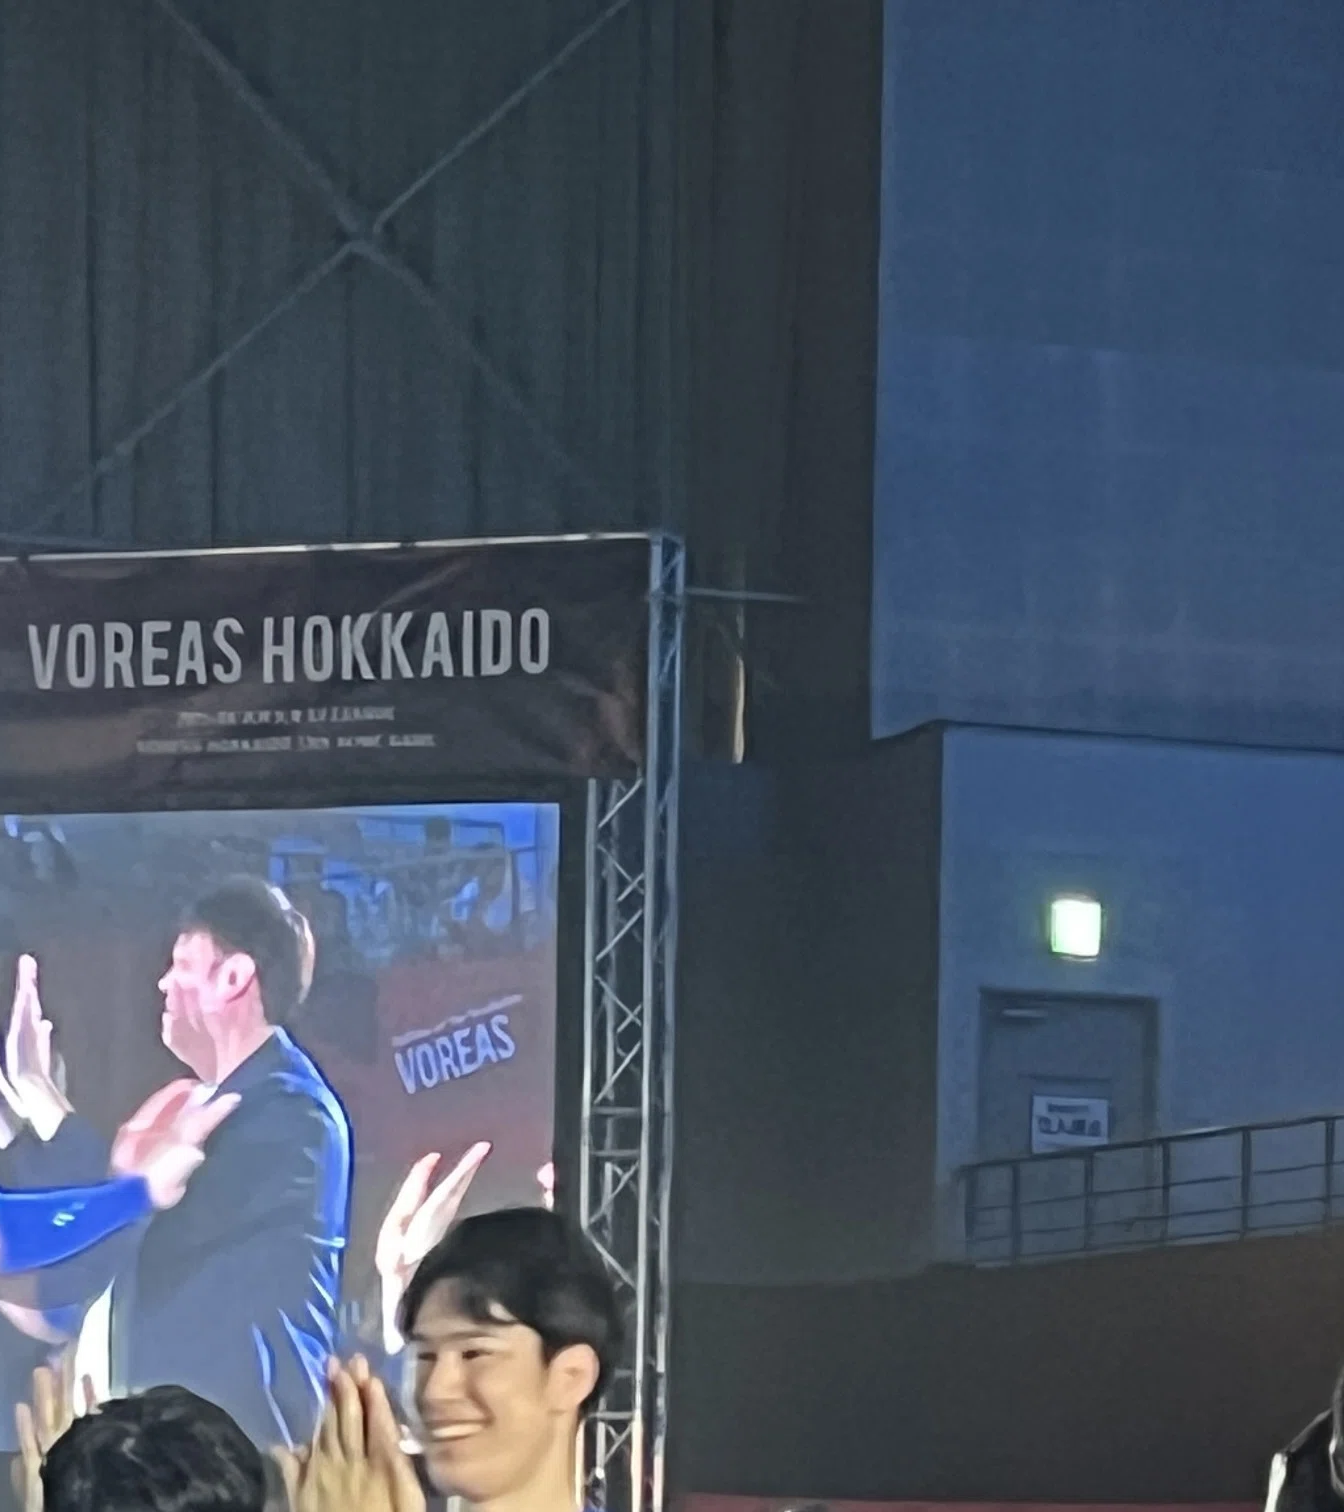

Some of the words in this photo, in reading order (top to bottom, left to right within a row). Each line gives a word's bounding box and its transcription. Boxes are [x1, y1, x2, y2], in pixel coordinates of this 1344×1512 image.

[28, 617, 245, 689] VOREAS
[262, 608, 551, 684] HOKKAIDO
[394, 1014, 516, 1095] VOREAS
